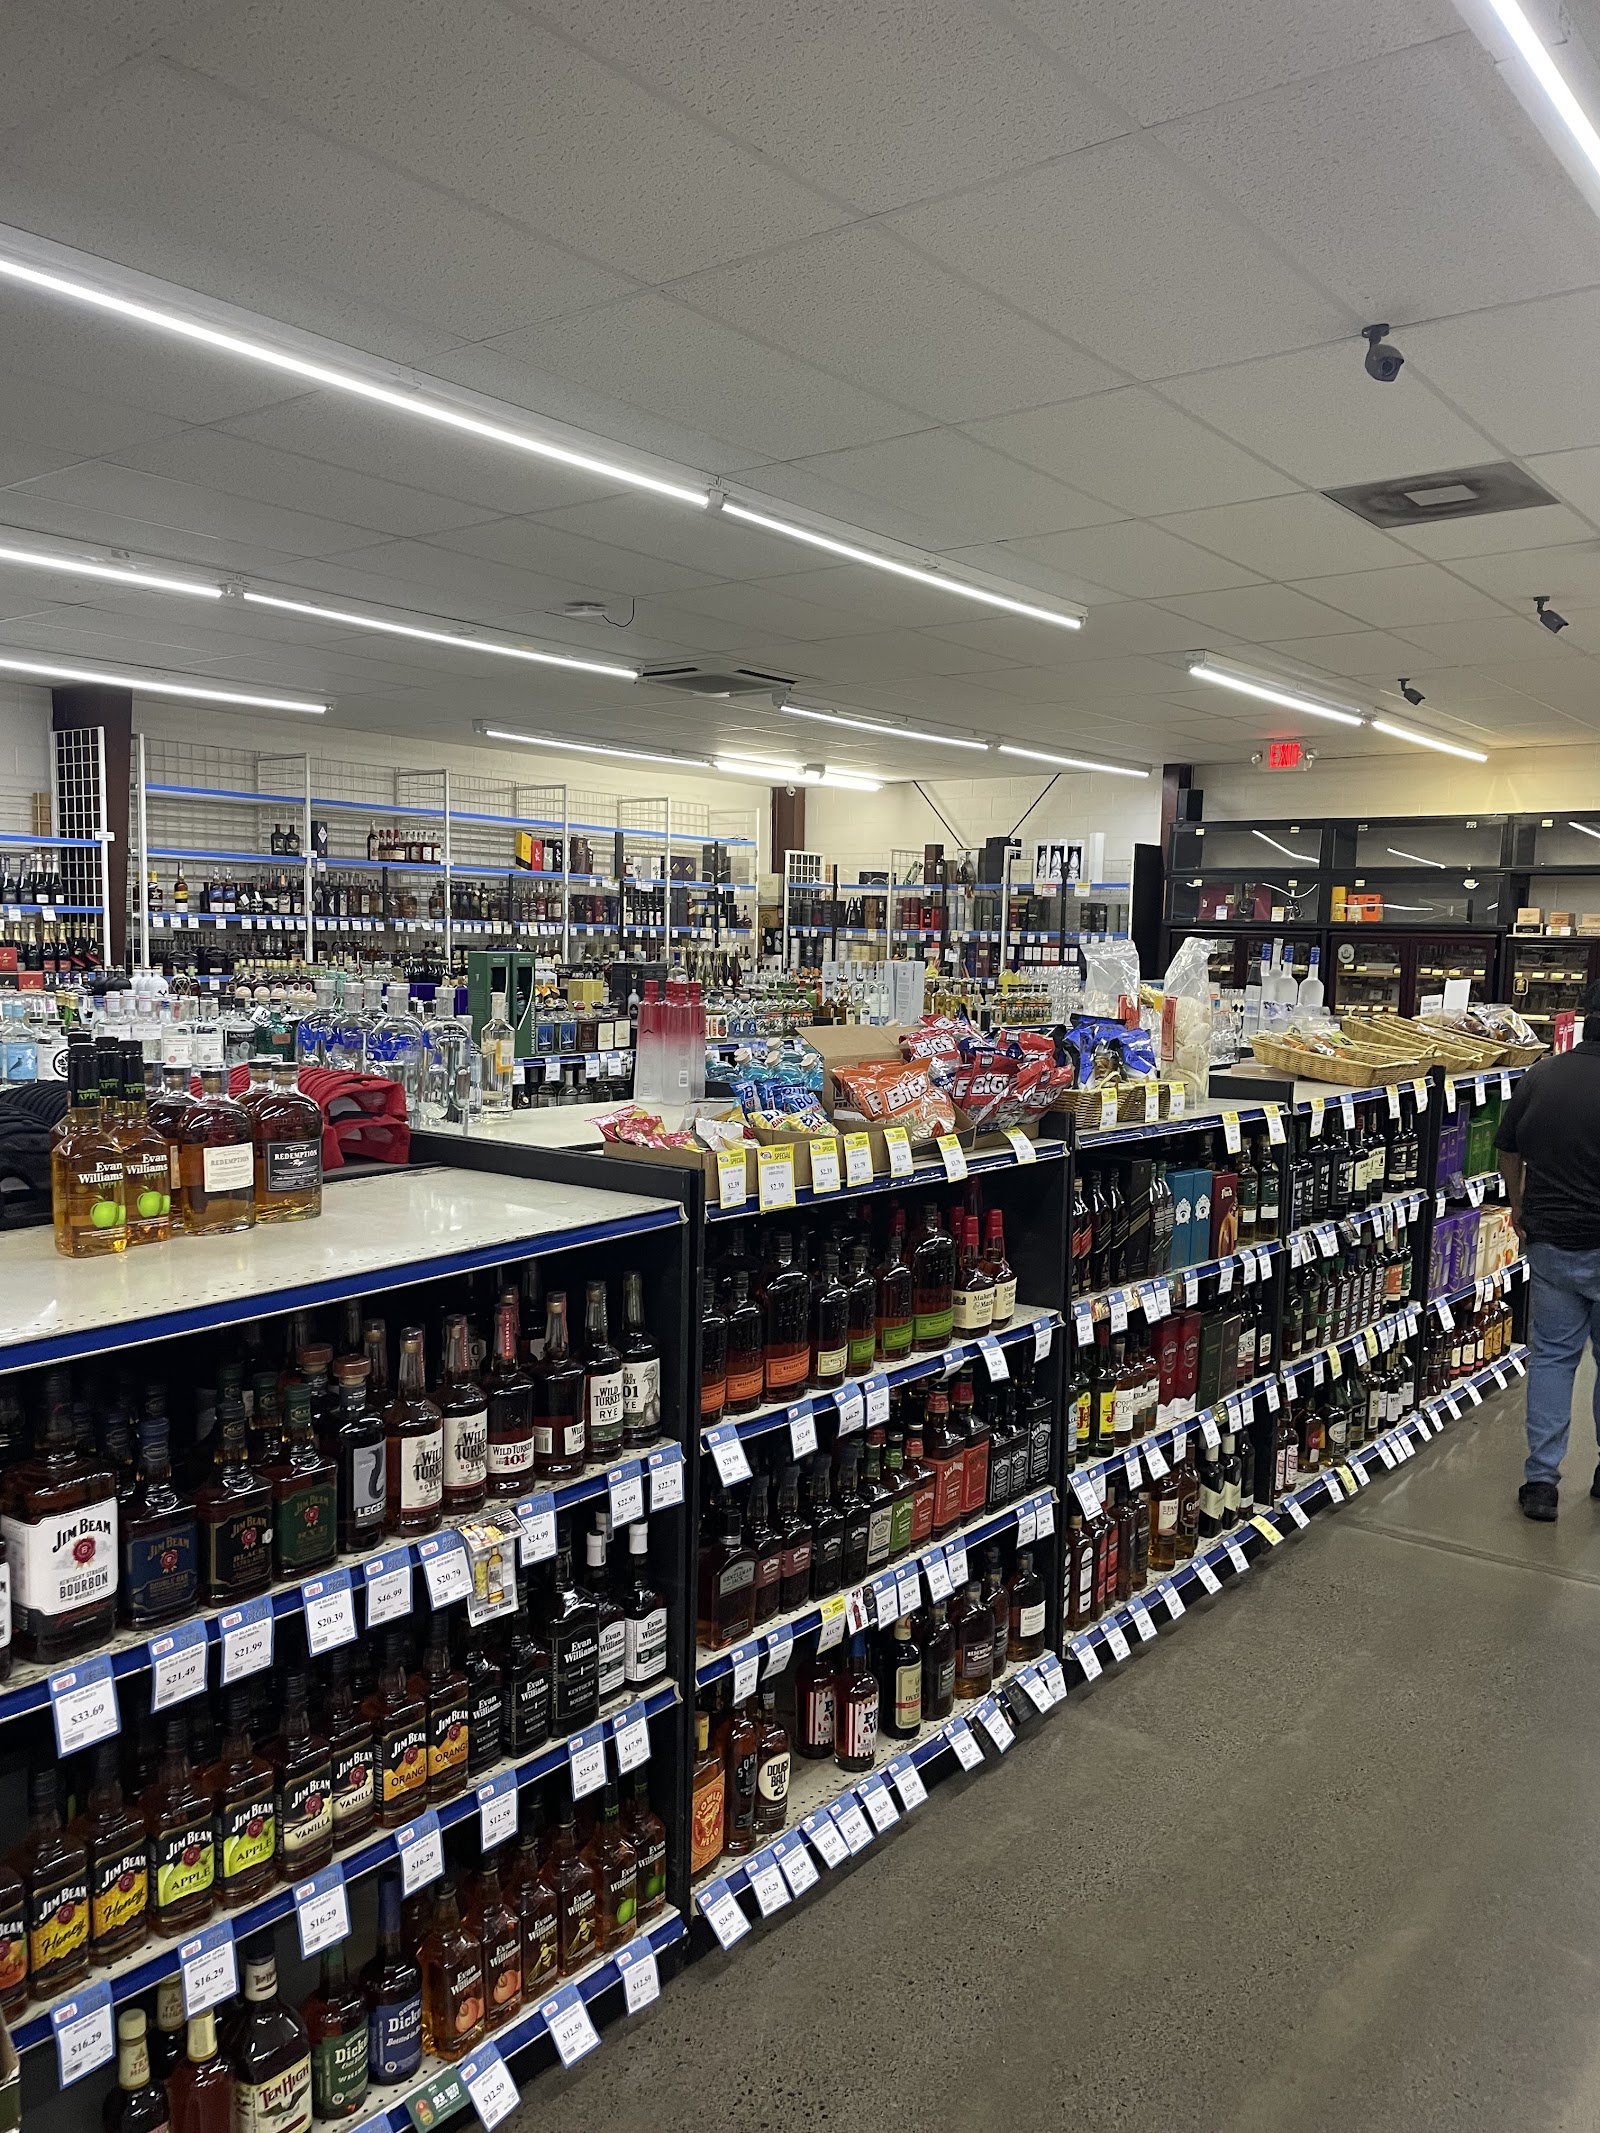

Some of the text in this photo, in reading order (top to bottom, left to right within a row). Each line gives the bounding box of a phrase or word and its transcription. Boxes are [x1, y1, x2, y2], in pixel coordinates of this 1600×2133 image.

[1270, 743, 1300, 768] EXIT
[142, 1154, 168, 1164] Evan
[211, 1156, 250, 1166] REDEMPTION
[274, 1149, 318, 1160] REDEMPTION
[774, 1152, 791, 1160] SPECIAL
[96, 1162, 123, 1172] Evan
[126, 1163, 168, 1174] Williams
[78, 1172, 124, 1184] Williams
[594, 1394, 620, 1407] TURKEY
[600, 1386, 618, 1397] WILD
[623, 1386, 639, 1398] 01
[600, 1408, 618, 1420] RYE
[624, 1401, 637, 1409] YE
[454, 1441, 487, 1460] TURKE
[492, 1442, 532, 1456] WILD TURKEY
[503, 1454, 526, 1466] 101
[658, 1478, 677, 1490] $22.79
[52, 1518, 112, 1553] JIM BEAM
[230, 1516, 268, 1538] JIM BEAM
[528, 1531, 549, 1544] $24.99
[147, 1536, 190, 1560] JIM BEAM
[60, 1565, 108, 1586] KENTUCKY STRAIGHT
[60, 1572, 108, 1598] BOURBON
[436, 1569, 461, 1586] $20.79
[722, 1567, 752, 1584] GENTLEMAN
[377, 1588, 402, 1604] $46.99
[317, 1612, 344, 1629] $20.39
[647, 1618, 662, 1630] Evan
[571, 1638, 592, 1652] Evan
[604, 1632, 620, 1643] Evan
[234, 1641, 263, 1660] $21.99
[564, 1644, 598, 1664] Williams
[166, 1665, 196, 1686] $21.49
[527, 1678, 544, 1692] Evan
[521, 1683, 549, 1702] Williams
[568, 1680, 595, 1696] KENTUCKY
[478, 1696, 497, 1710] Evan
[570, 1691, 594, 1706] BOURBON
[70, 1704, 105, 1726] $33.69
[472, 1700, 502, 1720] Williams
[436, 1710, 468, 1736] JIM BEAM
[391, 1732, 426, 1758] JIM BEAM
[336, 1752, 374, 1780] JIM BEAM
[770, 1772, 787, 1787] BALL
[292, 1779, 331, 1809] JIM BEAM
[340, 1786, 374, 1808] VANILLA
[232, 1802, 274, 1832] JIM BEAM
[489, 1808, 512, 1828] $12.59
[294, 1816, 331, 1840] VANILLA
[700, 1828, 720, 1846] HEAD
[166, 1830, 212, 1861] JIM BEAM
[236, 1838, 272, 1862] APPLE
[411, 1851, 434, 1872] $16.29
[102, 1855, 146, 1888] JIM BEAM
[171, 1868, 211, 1891] APPLE
[39, 1886, 87, 1921] JIM BEAM
[104, 1887, 145, 1922] Honey
[574, 1890, 592, 1906] Evan
[309, 1908, 338, 1930] $16.29
[534, 1914, 554, 1930] Evan
[42, 1918, 86, 1956] Honey
[496, 1940, 516, 1956] Evan
[194, 1966, 225, 1990] $16.29
[457, 1964, 476, 1982] Evan
[632, 1974, 652, 1992] $12.59
[562, 2022, 583, 2042] $12.59
[70, 2030, 103, 2056] $16.29
[260, 2088, 282, 2109] TEN
[282, 2064, 310, 2096] HIGH
[482, 2082, 506, 2106] $12.59
